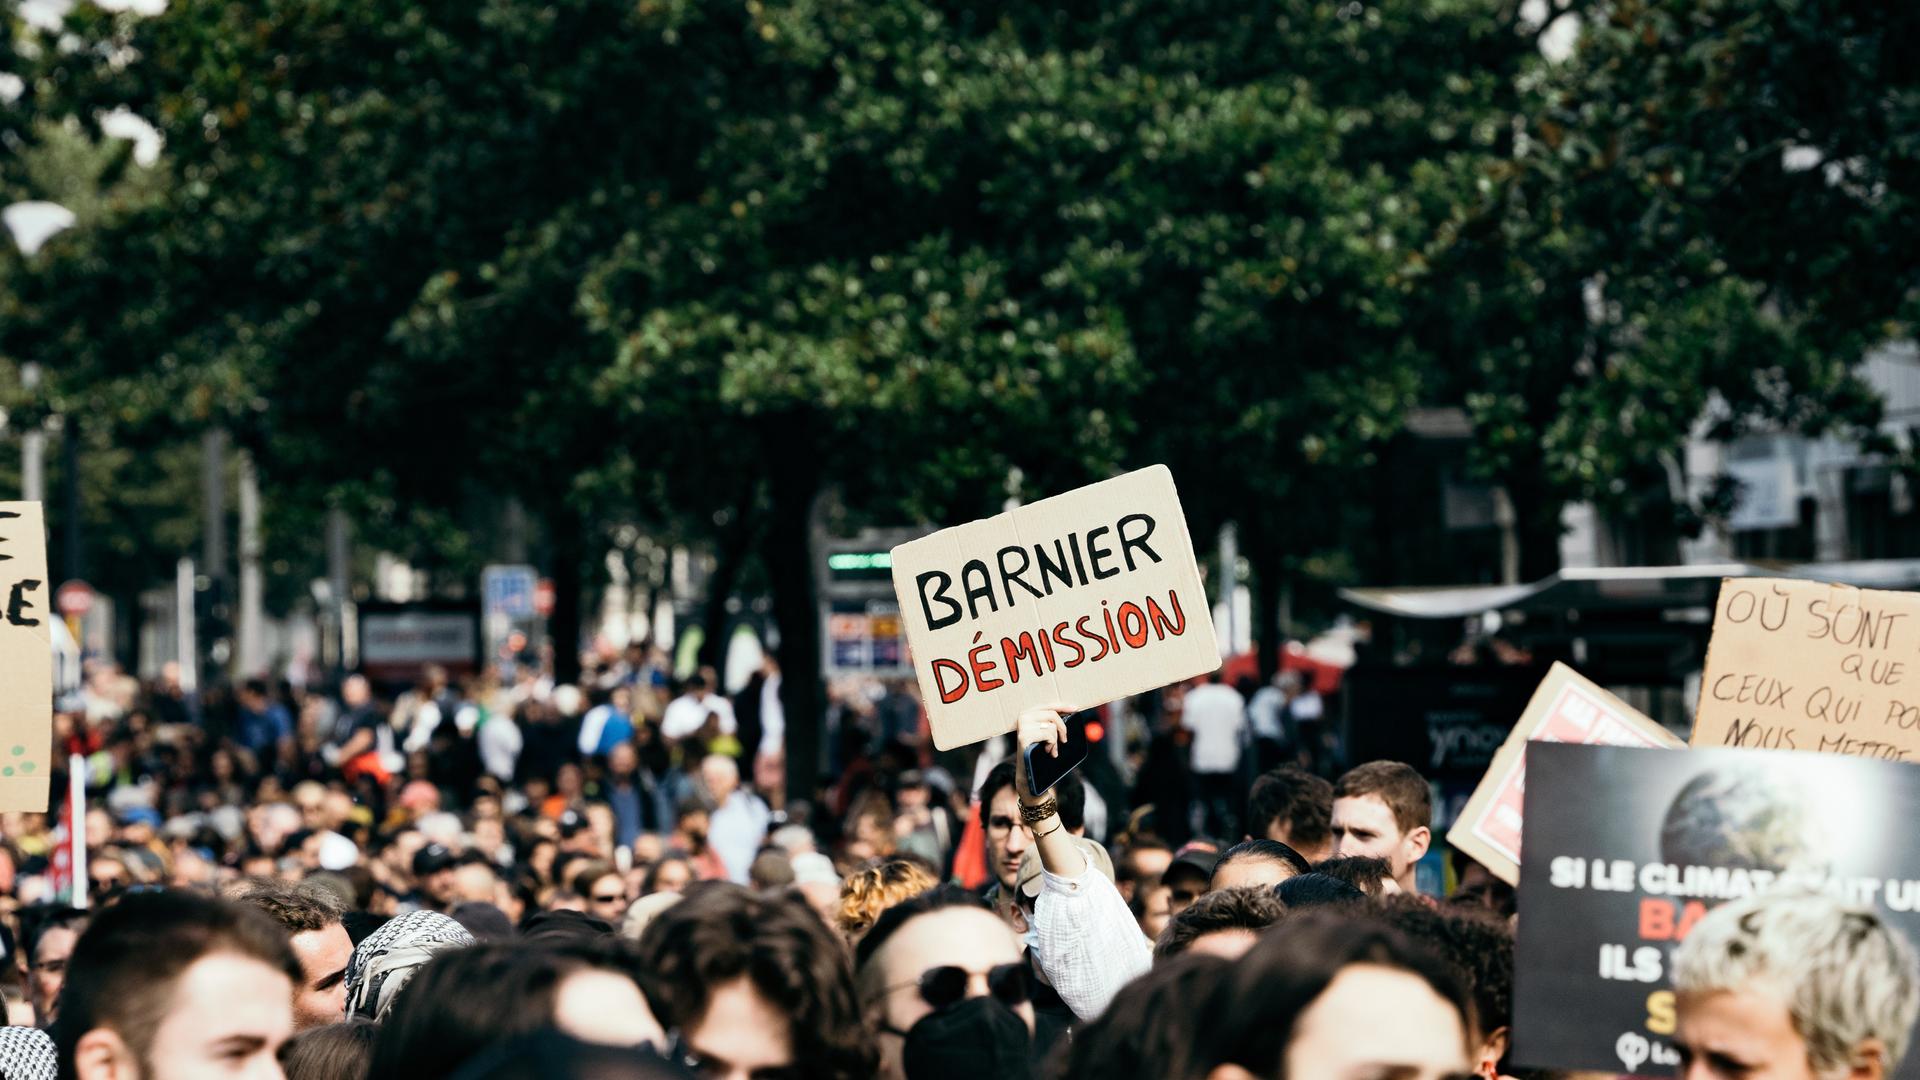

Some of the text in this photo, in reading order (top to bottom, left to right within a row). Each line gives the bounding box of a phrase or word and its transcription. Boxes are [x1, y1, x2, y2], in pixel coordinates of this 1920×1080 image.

[916, 513, 1162, 631] BARNIER
[0, 578, 42, 628] E
[1726, 584, 1910, 650] OÙ SONT
[1841, 654, 1905, 686] QUE
[1713, 673, 1793, 710] CEUX
[1884, 699, 1920, 731] PO
[1723, 717, 1797, 751] NOUS
[1550, 856, 1587, 889] SI
[1591, 858, 1636, 892] LE
[1638, 862, 1777, 899] CLIMAT
[1599, 943, 1664, 983] ILS
